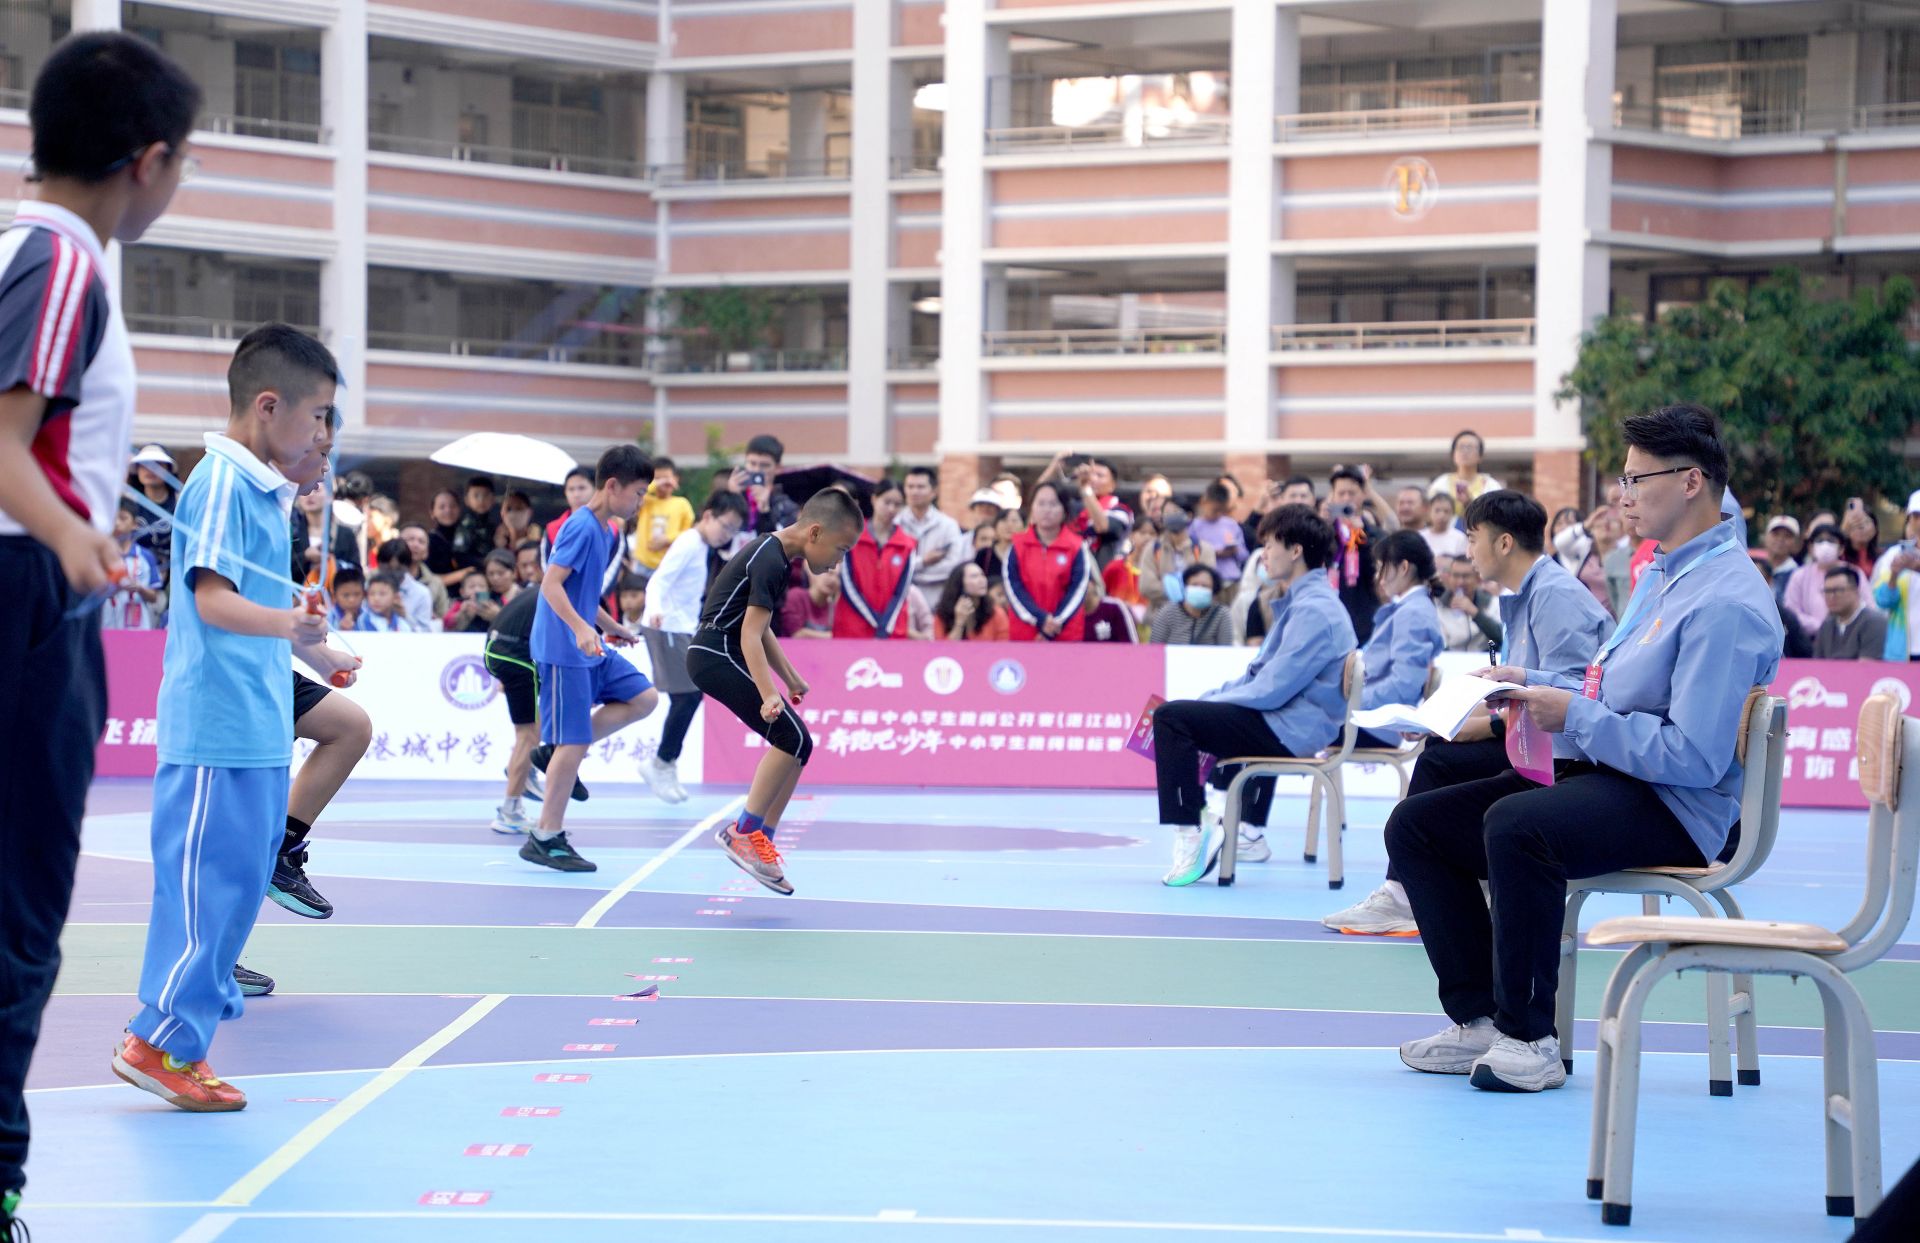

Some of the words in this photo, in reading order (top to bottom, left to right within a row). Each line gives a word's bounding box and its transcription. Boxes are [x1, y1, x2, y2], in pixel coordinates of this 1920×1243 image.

[300, 731, 494, 765] 港城中学
[583, 737, 659, 763] 护航
